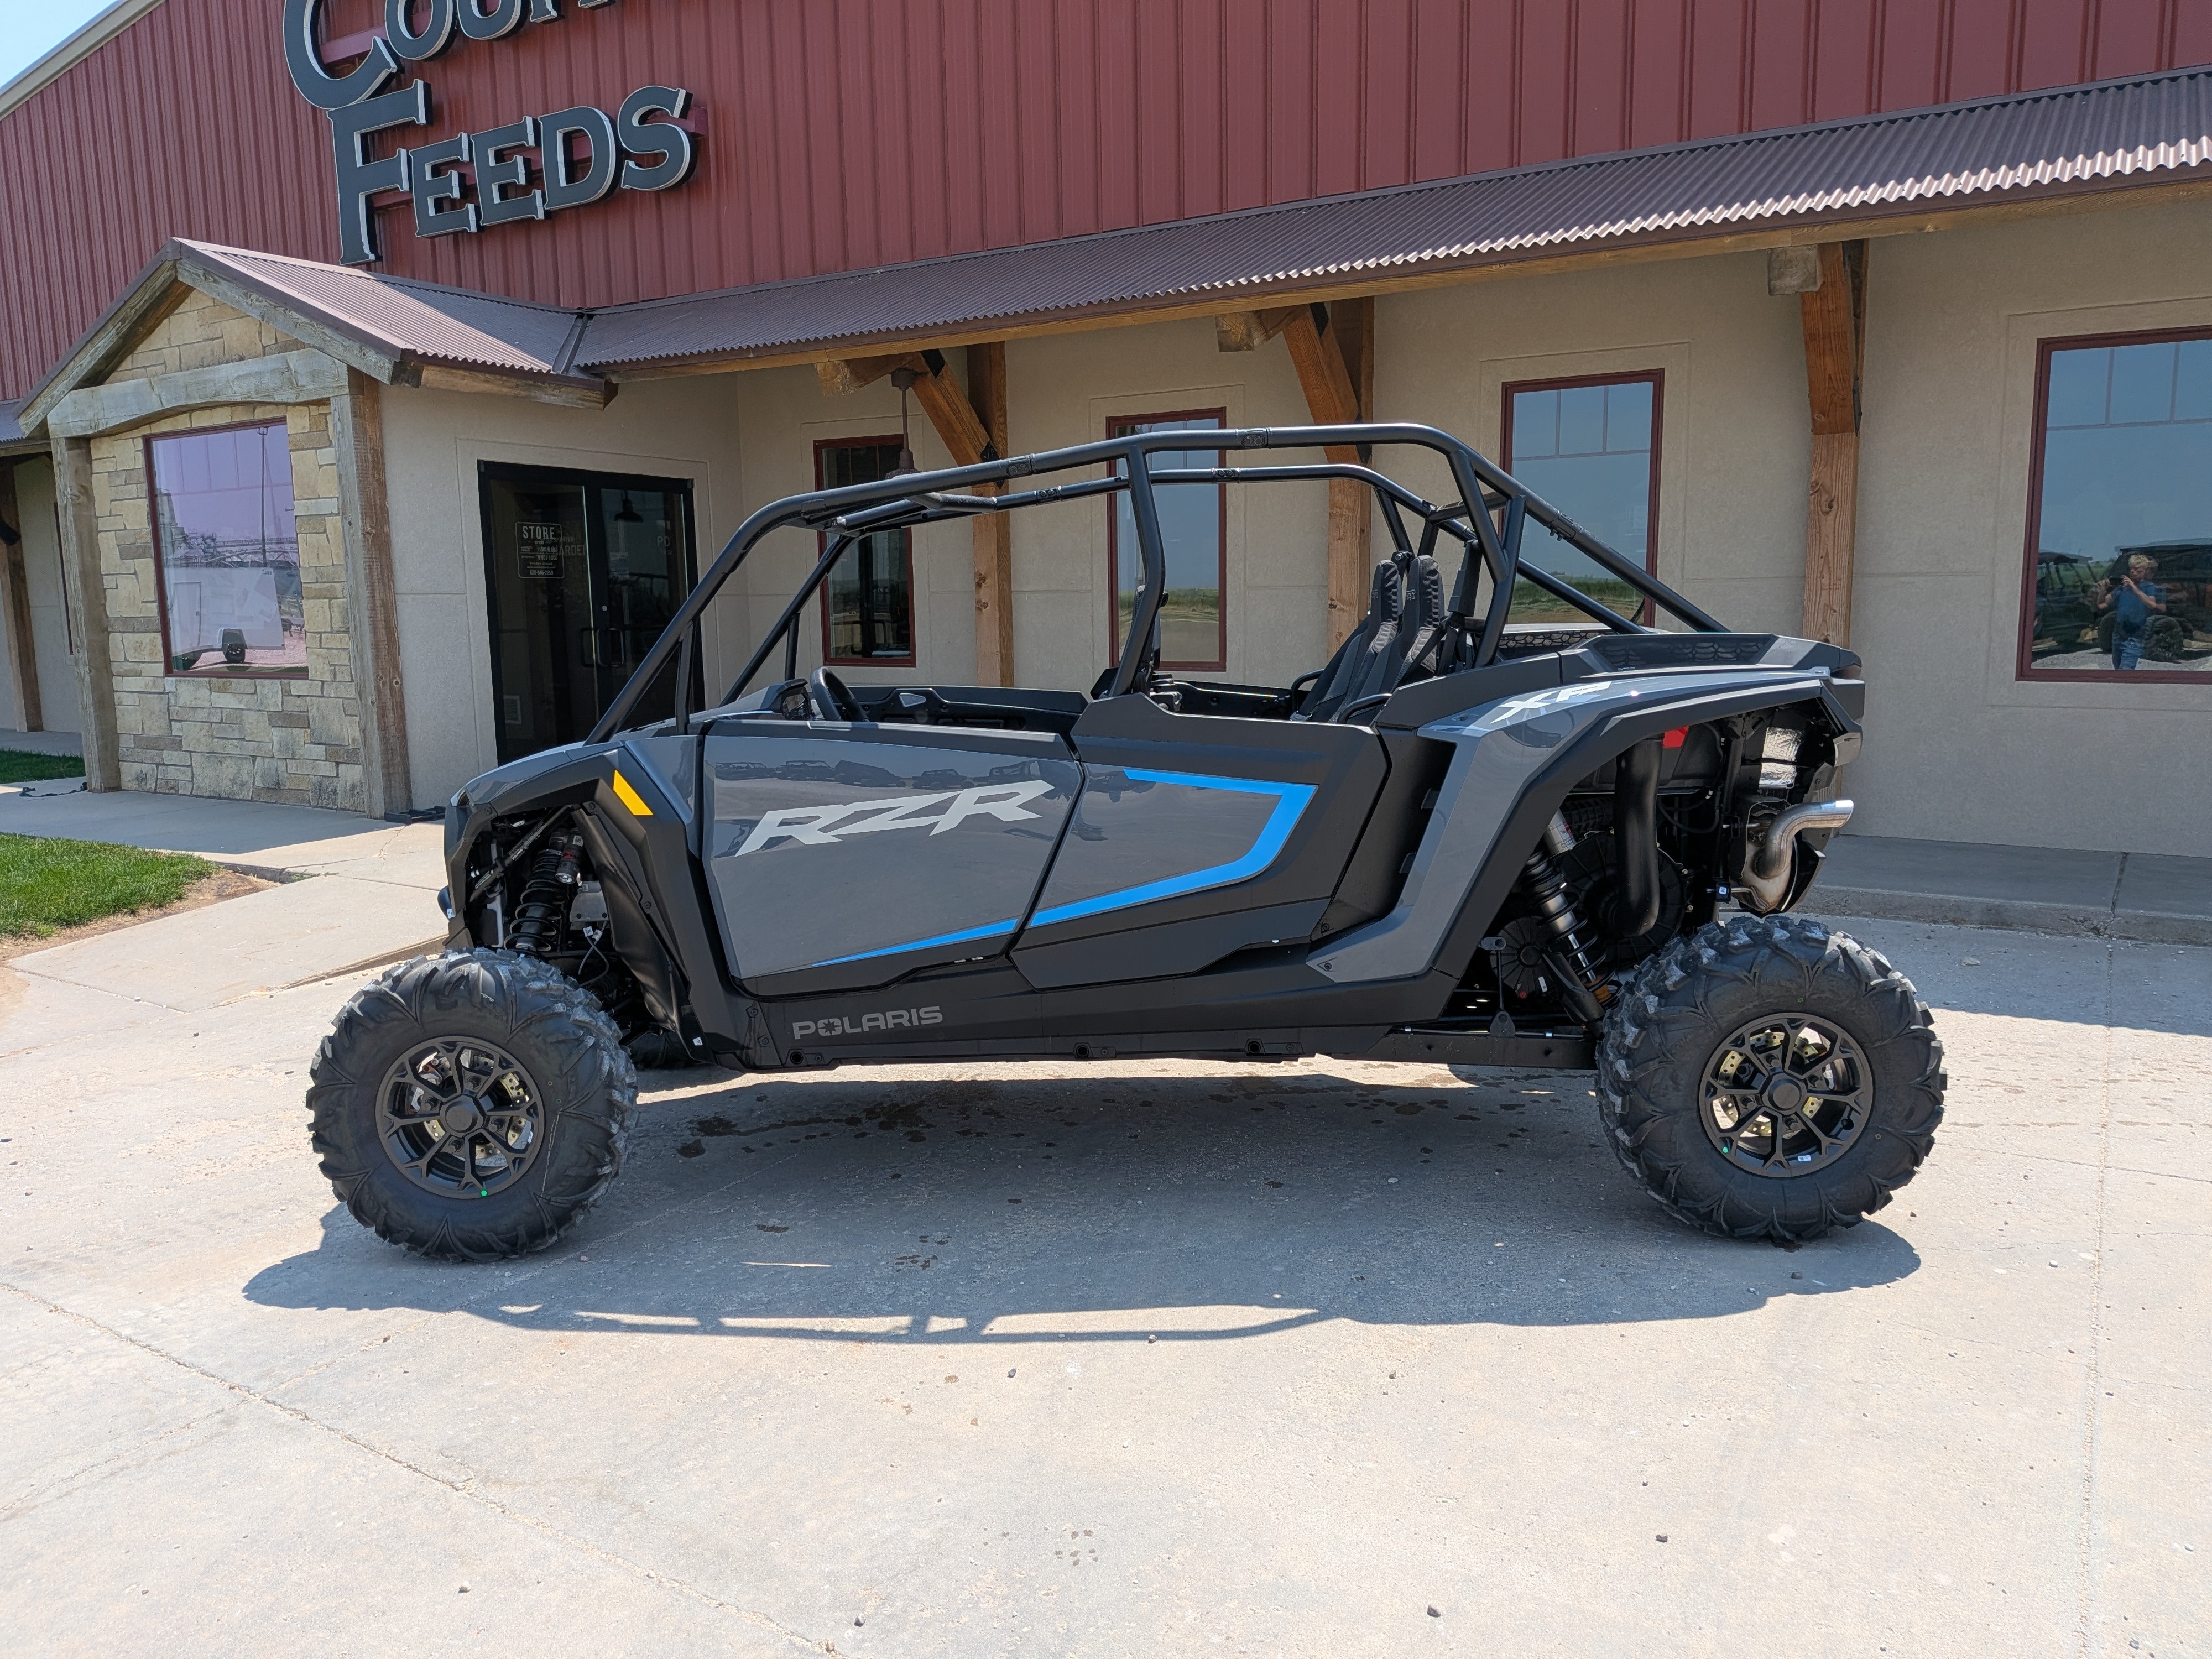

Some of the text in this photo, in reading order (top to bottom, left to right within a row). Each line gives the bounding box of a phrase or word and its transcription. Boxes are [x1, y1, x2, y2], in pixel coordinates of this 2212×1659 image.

[327, 79, 692, 266] FEEDS
[523, 526, 555, 539] STORE
[1490, 681, 1612, 724] XP
[734, 780, 1055, 857] RZR
[792, 1006, 943, 1040] POLARIS
